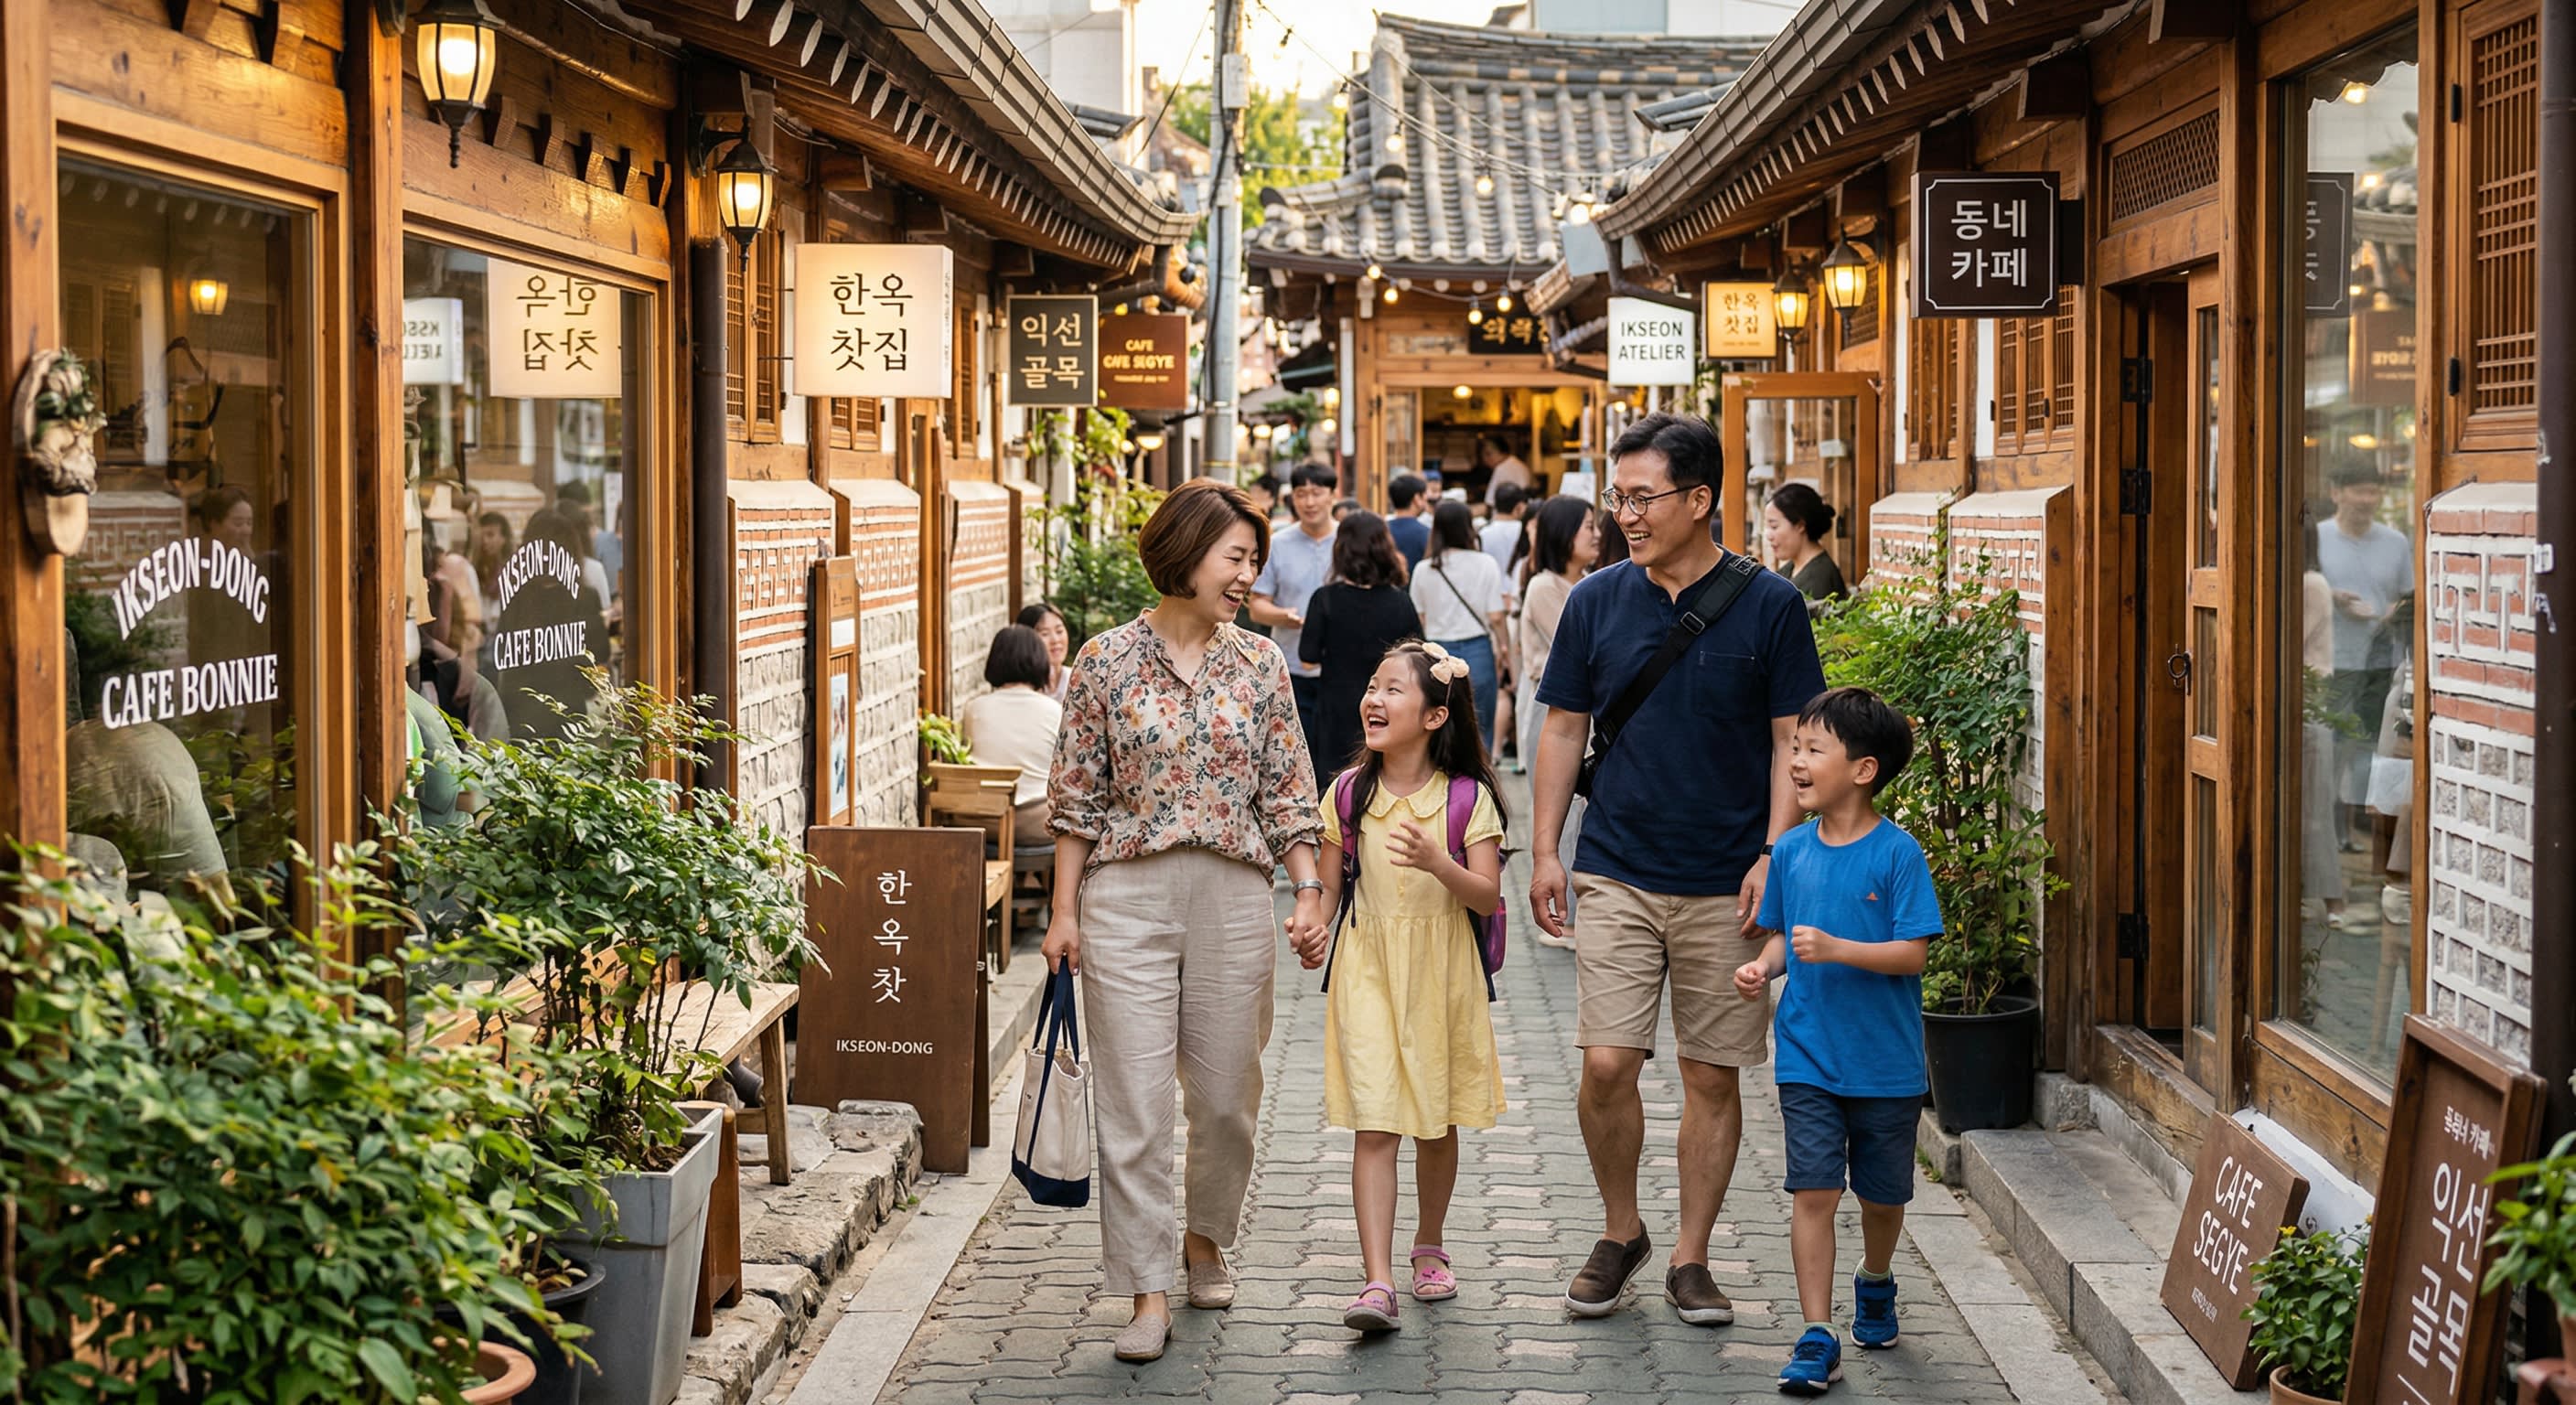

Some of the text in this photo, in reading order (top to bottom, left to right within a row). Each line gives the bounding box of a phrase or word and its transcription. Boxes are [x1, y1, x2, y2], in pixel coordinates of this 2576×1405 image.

[1951, 199, 2027, 241] 동네
[1951, 248, 2027, 287] 카페
[830, 273, 913, 317] 한옥
[1723, 293, 1760, 311] 한옥
[1021, 312, 1083, 348] 익선
[1125, 338, 1154, 352] CAFE
[1621, 321, 1683, 337] IKSEON
[1724, 315, 1759, 335] 찻집
[831, 327, 907, 371] 찻집
[1618, 345, 1686, 359] ATELIER
[1020, 356, 1085, 391] 골목
[112, 537, 270, 641] IKSEON-DONG
[498, 538, 580, 611] IKSEON-DONG
[493, 620, 586, 670] CAFE BONNIE
[102, 654, 278, 730] CAFE BONNIE
[872, 869, 912, 1003] 한옥찻
[836, 1039, 933, 1055] IKSEON-DONG
[2215, 1155, 2264, 1229] CAFE
[2431, 1163, 2488, 1282] 익선
[2193, 1210, 2249, 1296] SEGYE
[2408, 1264, 2468, 1396] 골목
